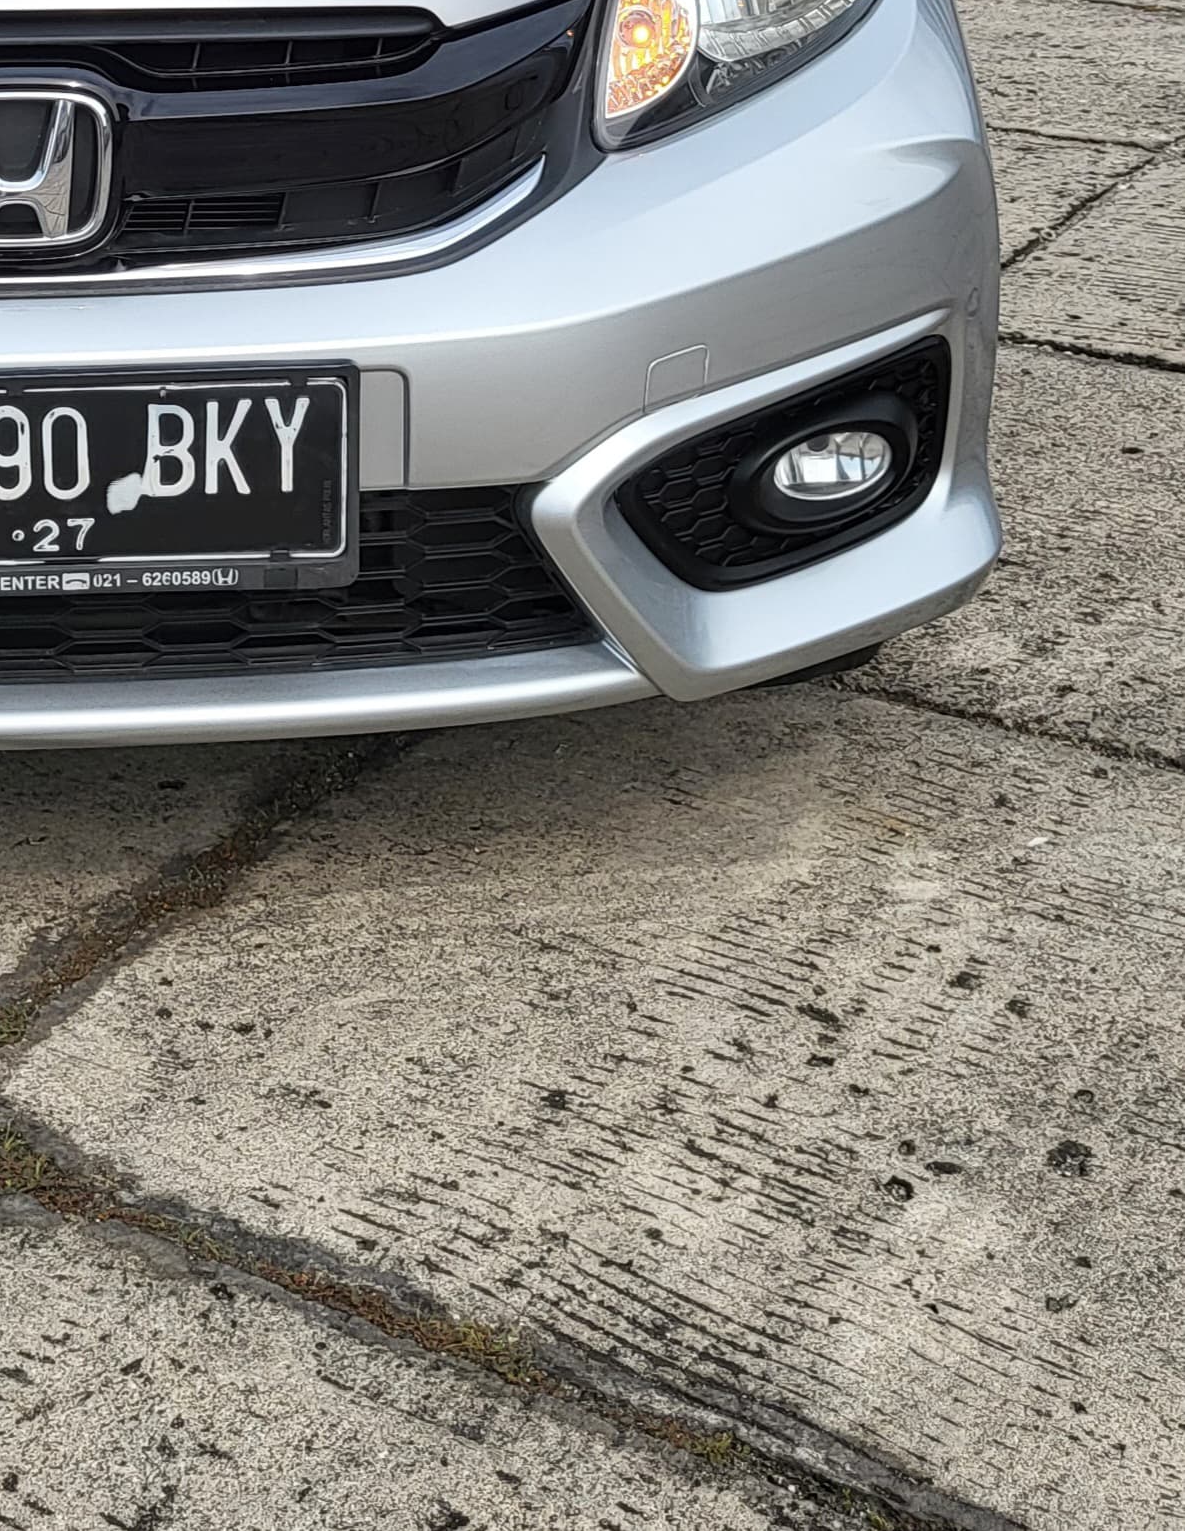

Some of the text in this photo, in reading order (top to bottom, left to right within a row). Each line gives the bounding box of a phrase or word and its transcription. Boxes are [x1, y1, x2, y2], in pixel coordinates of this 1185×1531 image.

[144, 397, 311, 498] BKY
[93, 573, 122, 588] 021
[141, 571, 212, 587] 6260589
